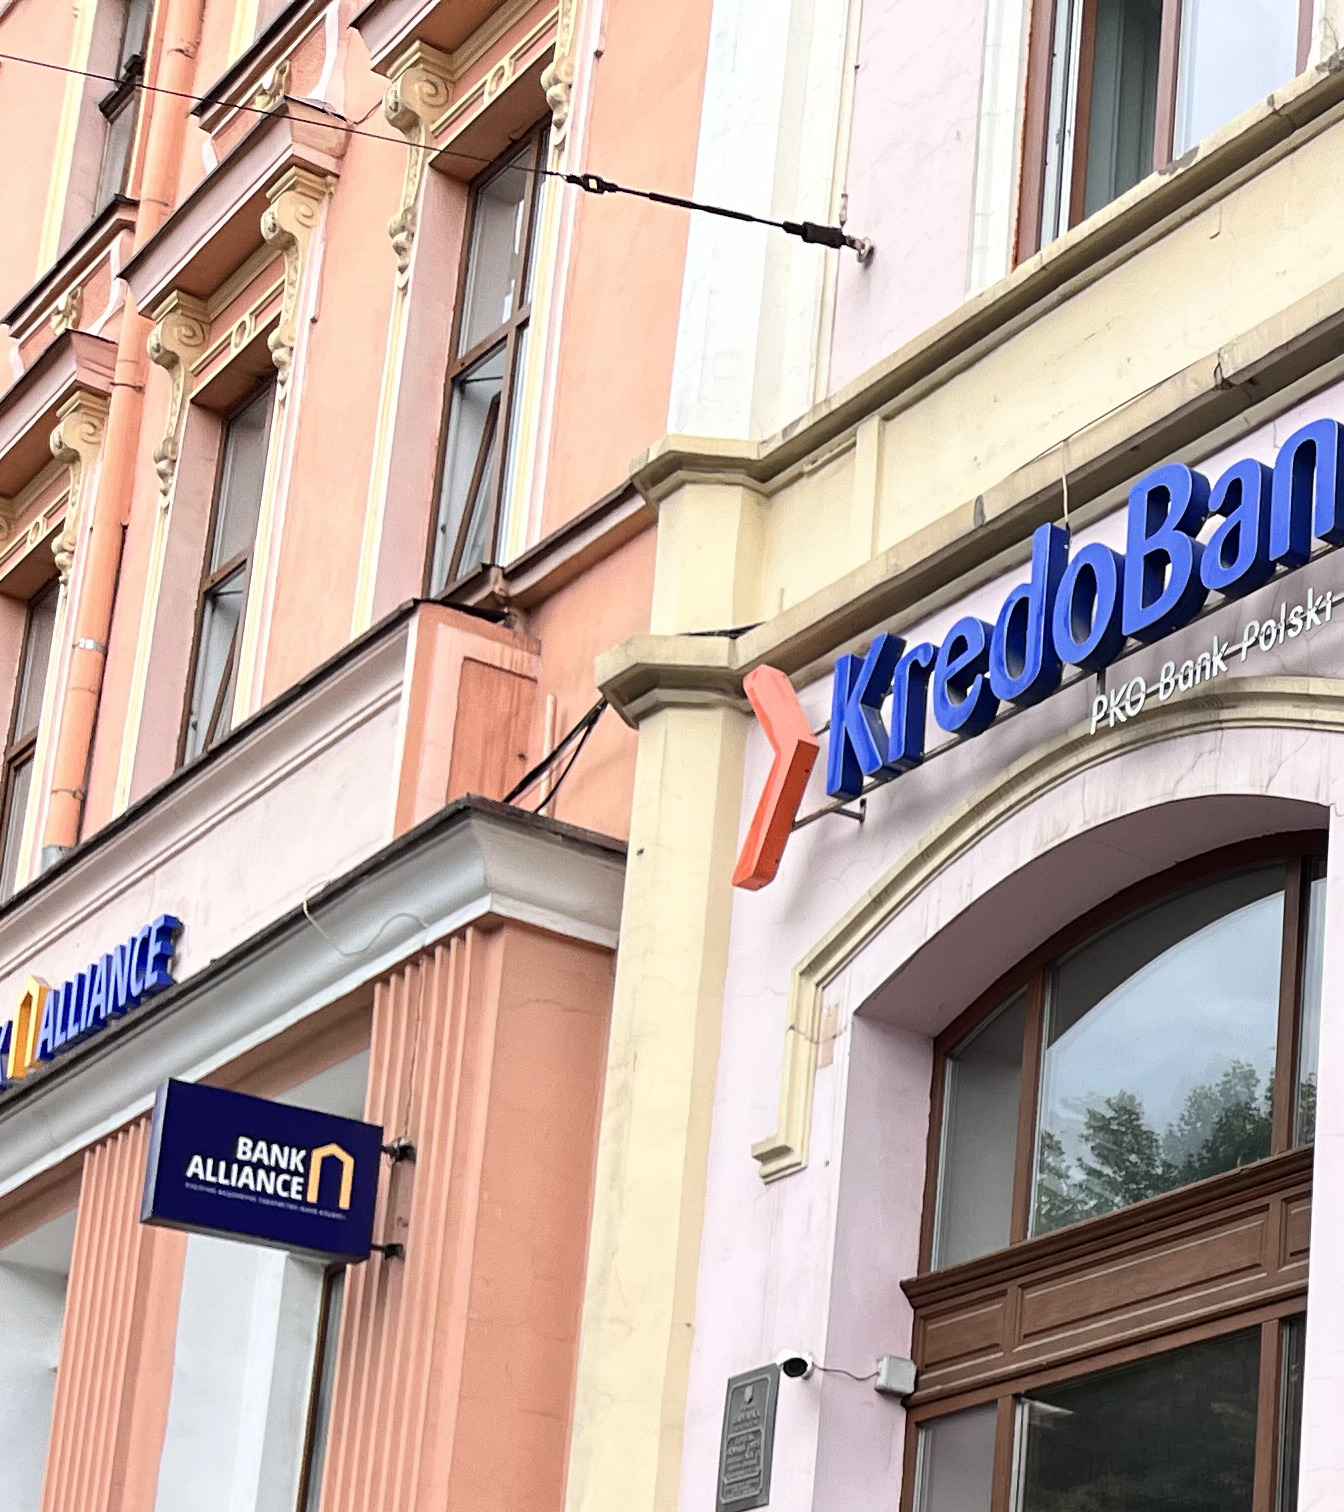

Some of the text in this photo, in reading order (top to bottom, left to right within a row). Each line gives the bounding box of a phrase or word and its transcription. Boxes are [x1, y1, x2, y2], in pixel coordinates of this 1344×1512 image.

[1089, 676, 1145, 735] PKO
[1158, 635, 1230, 700] Bank
[1240, 587, 1333, 663] Polski
[36, 914, 182, 1062] ALLIANCE
[186, 1154, 305, 1200] ALLIANCE
[236, 1135, 307, 1173] BANK
